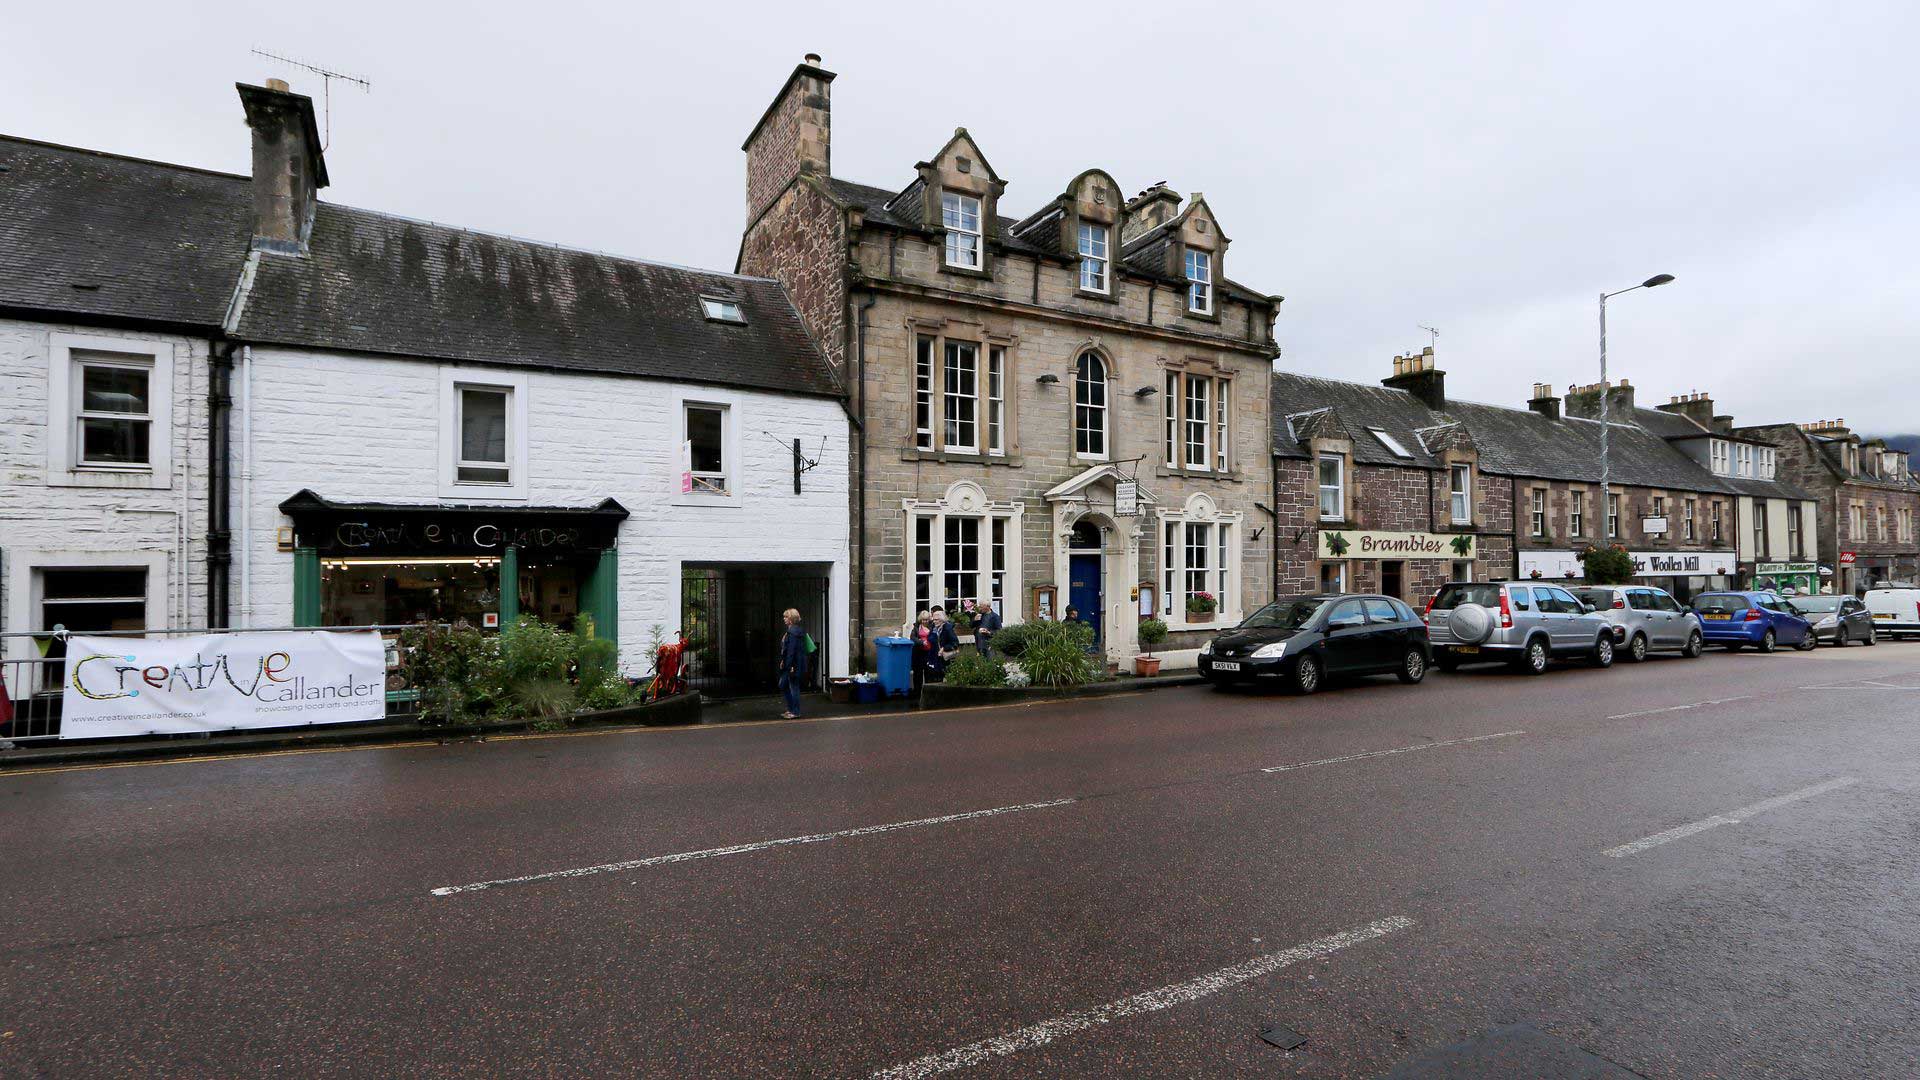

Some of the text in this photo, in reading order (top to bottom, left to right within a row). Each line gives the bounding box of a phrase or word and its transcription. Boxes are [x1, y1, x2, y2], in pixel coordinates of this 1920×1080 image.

[1360, 535, 1444, 553] Brambles
[1650, 556, 1682, 571] Woollen
[1684, 556, 1699, 571] Mill
[1841, 553, 1855, 561] illy
[255, 673, 380, 703] Callander
[255, 704, 303, 713] showcasing
[304, 702, 325, 710] local
[71, 711, 208, 723] www.creativeincallander.co.uk
